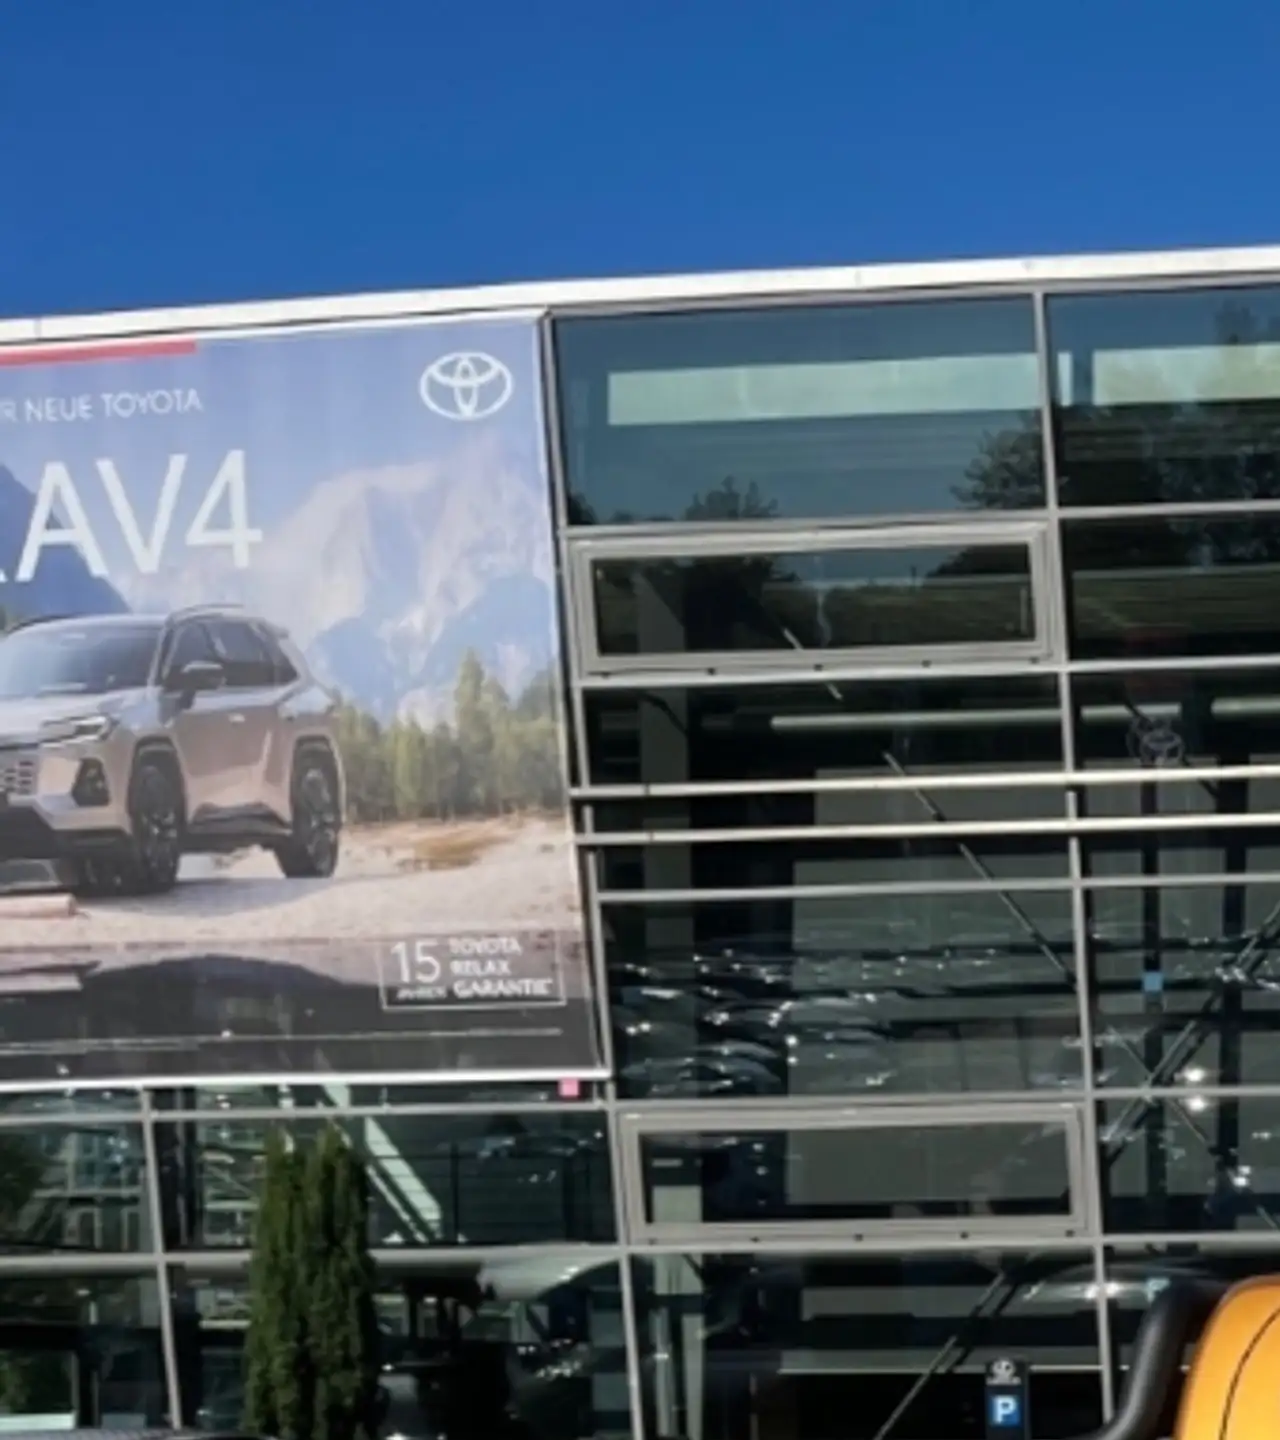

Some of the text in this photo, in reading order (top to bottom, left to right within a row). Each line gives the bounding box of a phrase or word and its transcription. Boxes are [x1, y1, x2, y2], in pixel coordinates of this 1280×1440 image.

[25, 394, 94, 422] NEUE
[101, 387, 204, 418] TOYOTA
[0, 449, 263, 583] AV4
[390, 941, 441, 984] 15
[449, 937, 523, 955] TOYOTA
[453, 977, 554, 999] GARANTIE
